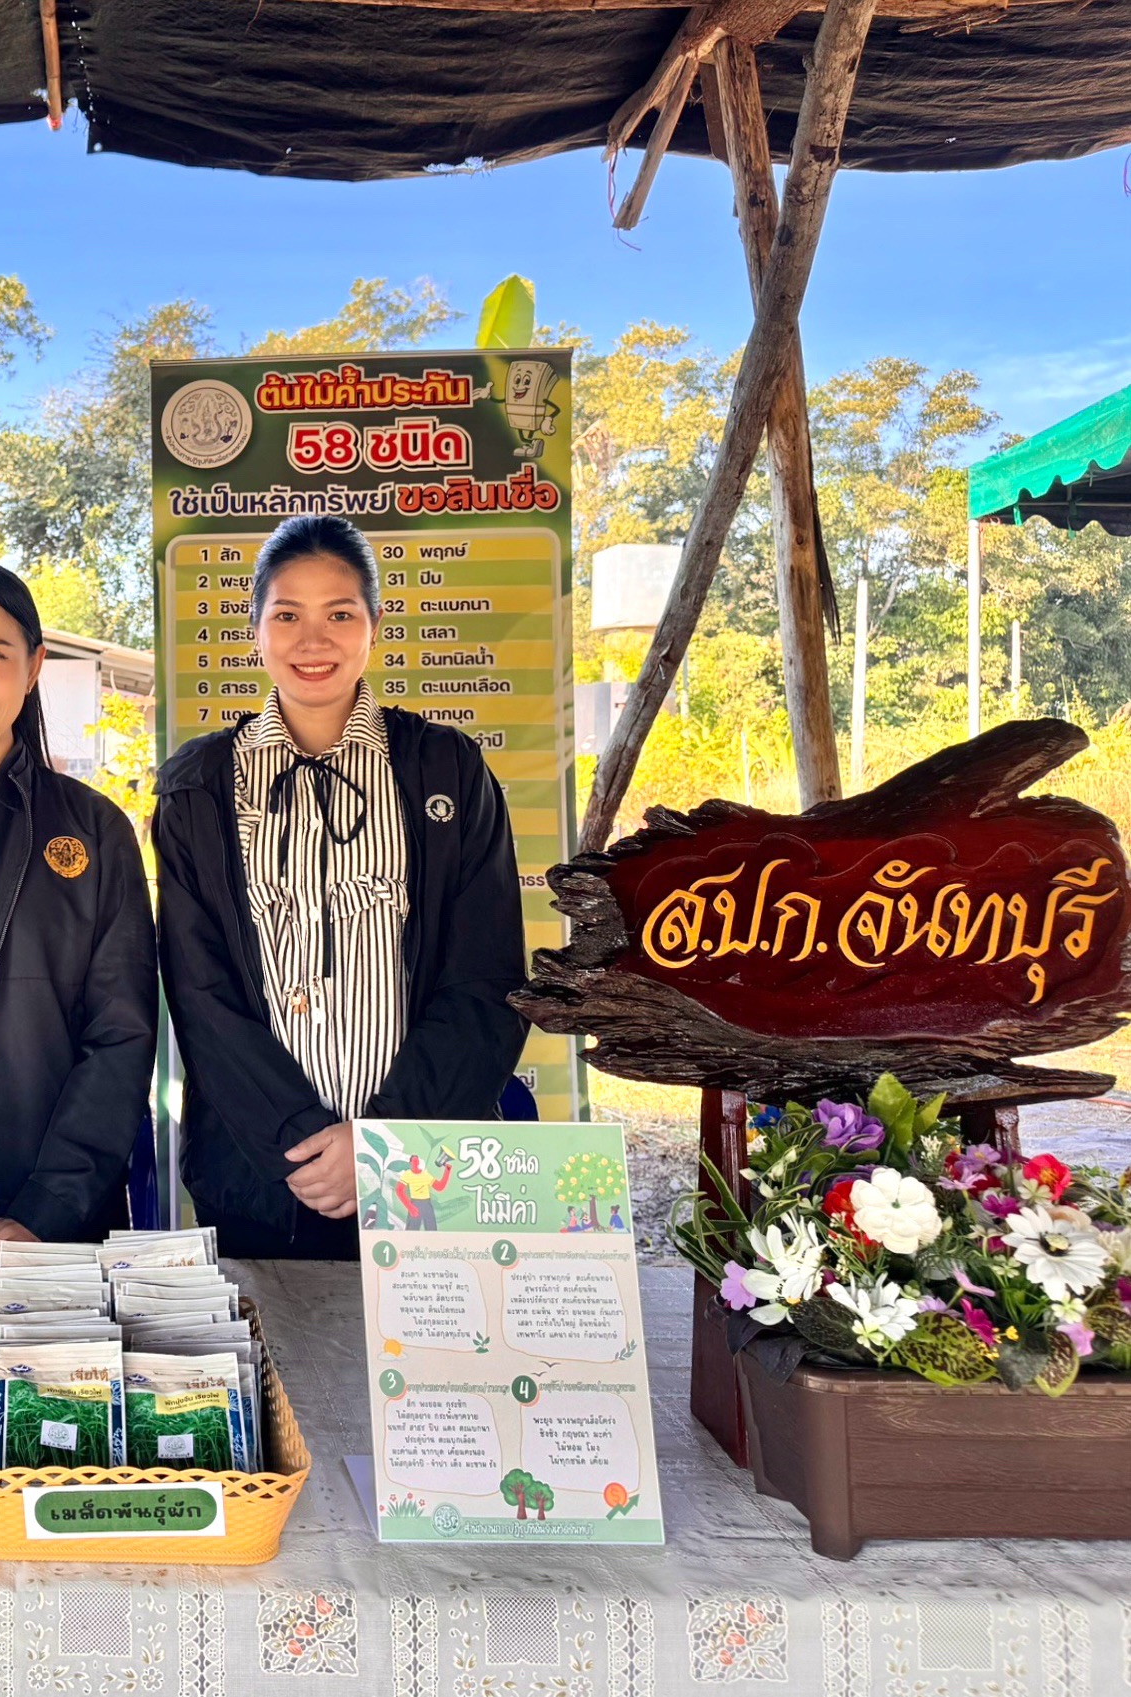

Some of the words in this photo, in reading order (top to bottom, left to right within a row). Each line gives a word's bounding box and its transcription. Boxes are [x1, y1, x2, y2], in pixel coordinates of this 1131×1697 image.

[257, 367, 469, 409] ต้นไม้ค้ำประกัน
[292, 428, 355, 466] 58
[369, 423, 463, 463] ชนิด
[171, 482, 394, 515] ใช้เป็นหลักทรัพย์
[398, 467, 558, 513] ขอสินเชื่อ
[200, 549, 209, 562] 1
[220, 546, 241, 562] สัก
[382, 546, 404, 559] 30
[420, 542, 468, 561] พฤกษ์
[198, 576, 208, 588] 2
[220, 577, 251, 591] พะยู
[387, 573, 405, 586] 31
[420, 571, 442, 585] ปีบ
[198, 602, 208, 614] 3
[220, 600, 250, 614] ชิงชั
[384, 600, 405, 613] 32
[420, 599, 490, 612] ตะแบกนา
[197, 628, 208, 641] 4
[384, 627, 405, 640] 33
[421, 626, 456, 639] เสลา
[198, 655, 208, 667] 5
[384, 654, 405, 667] 34
[421, 646, 494, 666] อินทนิลน้ำ
[198, 682, 208, 694] 6
[220, 682, 258, 694] สาธร
[385, 681, 406, 694] 35
[421, 678, 511, 693] ตะแบกเลือด
[199, 708, 209, 721] 7
[457, 1136, 503, 1181] 58
[503, 1147, 539, 1175] ชนิด
[462, 1183, 538, 1225] ไม้มีค่า
[382, 1245, 390, 1263] 1
[500, 1243, 510, 1261] 2
[387, 1372, 397, 1389] 3
[519, 1381, 529, 1399] 4
[50, 1493, 202, 1526] เมล็ดพันธุ์ผัก
